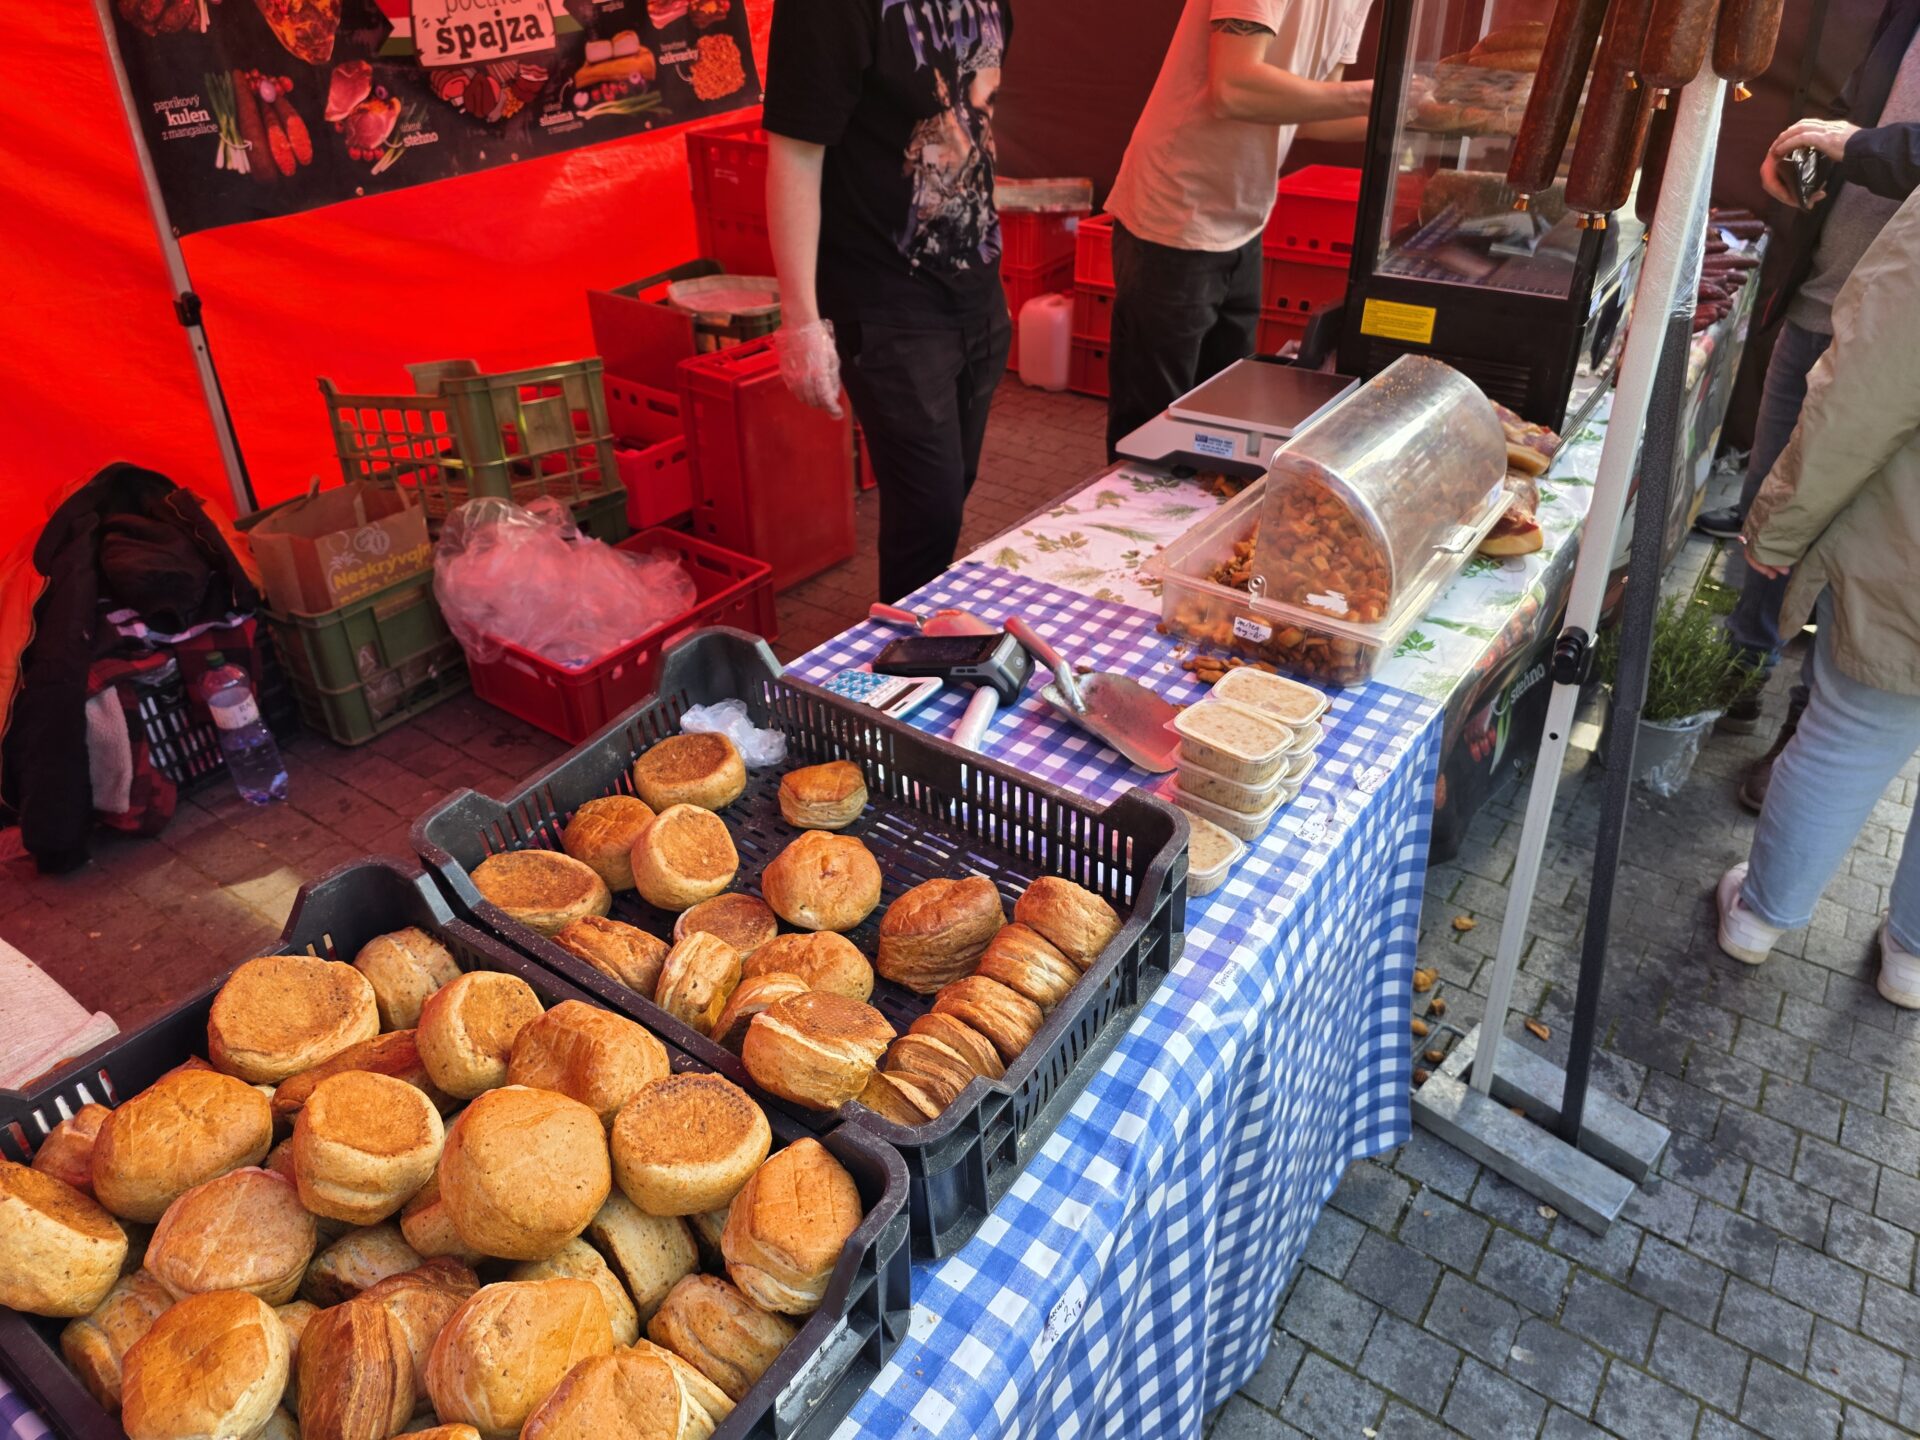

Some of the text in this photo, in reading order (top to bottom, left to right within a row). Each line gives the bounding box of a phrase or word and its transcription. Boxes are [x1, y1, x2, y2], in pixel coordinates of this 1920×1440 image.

[436, 10, 545, 59] špajza
[153, 94, 200, 113] paprikový
[165, 108, 211, 126] kulen
[168, 123, 218, 139] mangalice
[403, 131, 439, 147] stehno
